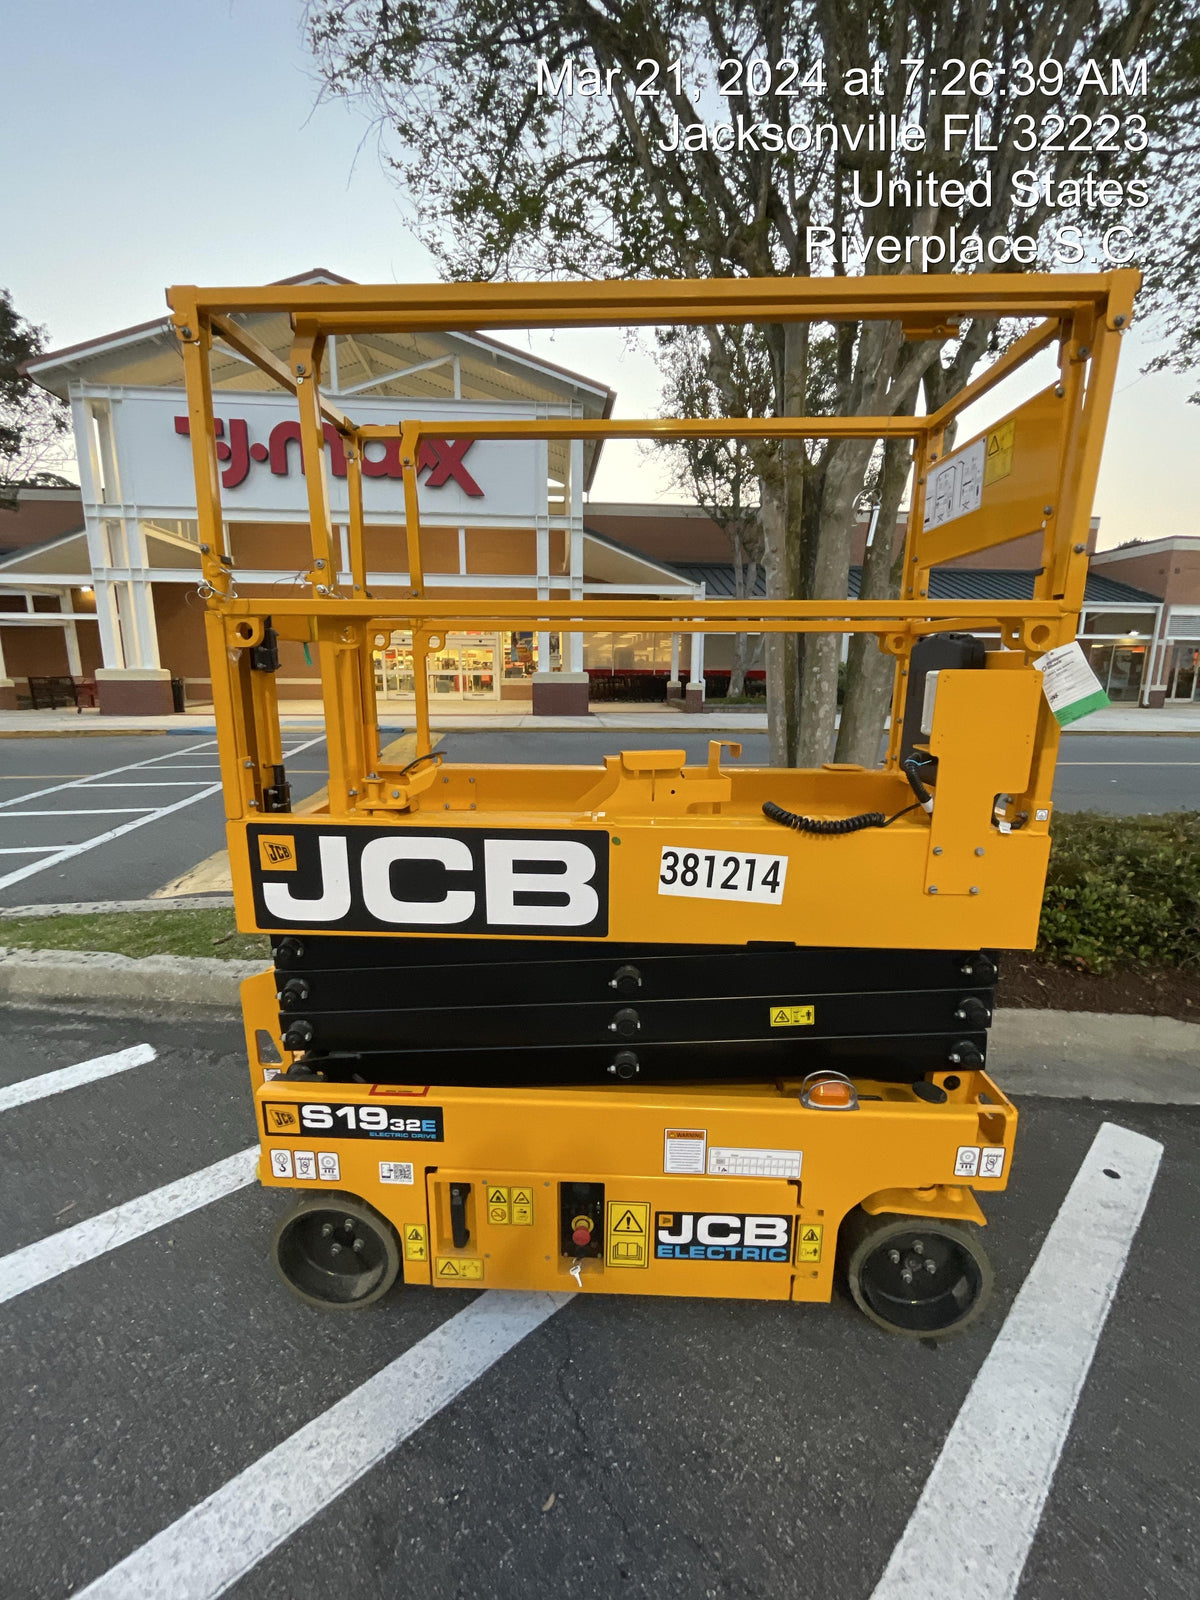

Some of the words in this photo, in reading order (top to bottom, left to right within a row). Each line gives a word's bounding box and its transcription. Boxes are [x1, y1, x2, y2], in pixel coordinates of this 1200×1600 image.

[266, 842, 292, 864] JCB
[263, 835, 599, 926] JCB
[660, 851, 780, 893] 381214
[275, 1110, 295, 1127] JCB
[369, 1131, 409, 1139] ELECTRIC
[658, 1214, 788, 1247] JCB
[657, 1245, 787, 1262] ELECTRIC
